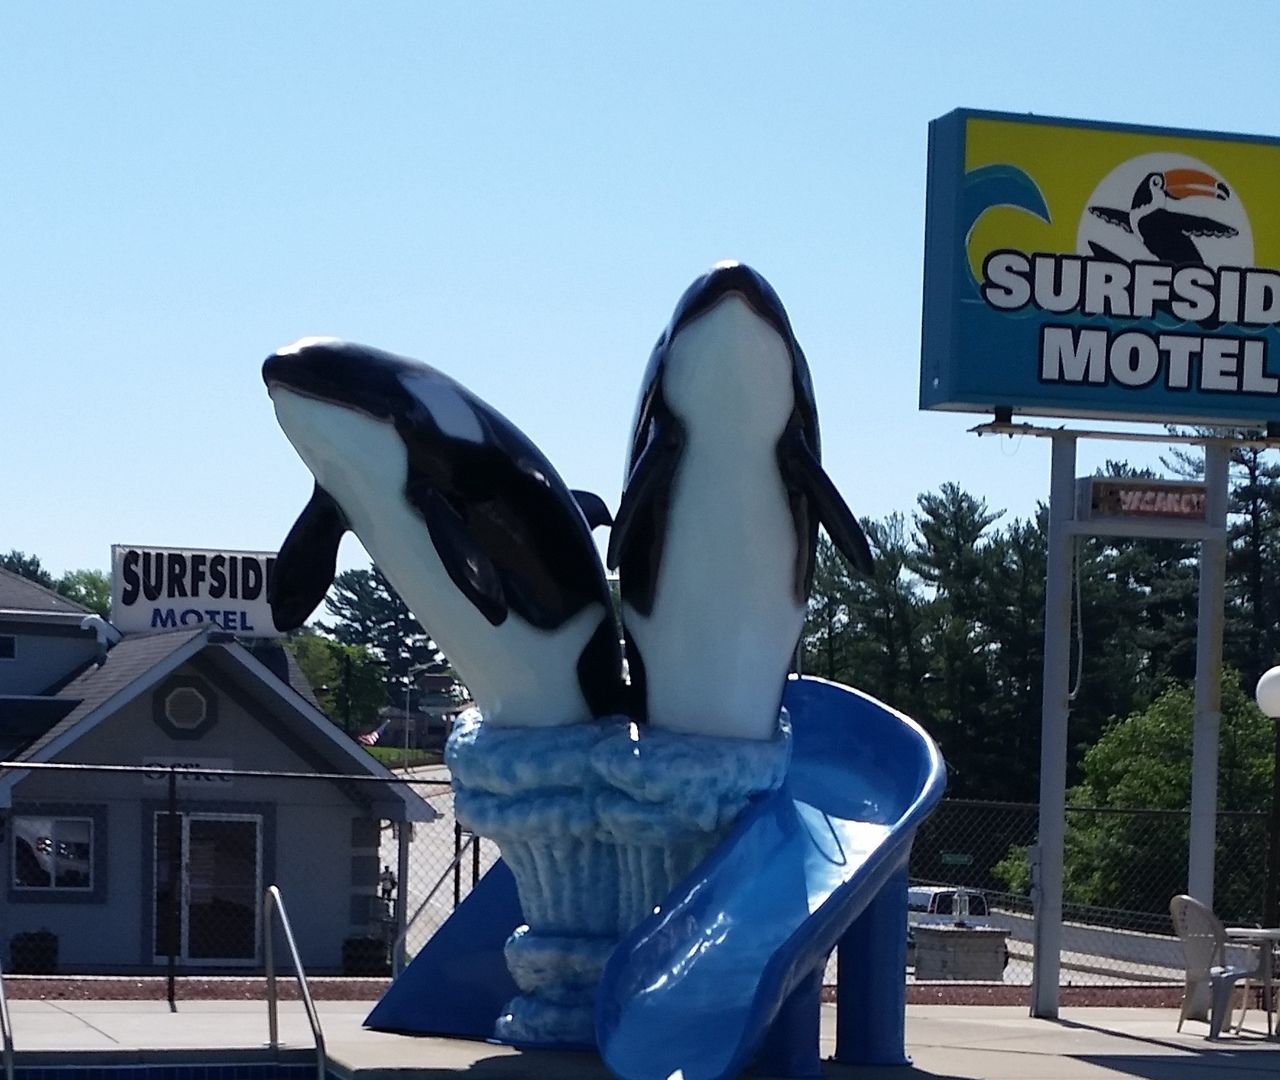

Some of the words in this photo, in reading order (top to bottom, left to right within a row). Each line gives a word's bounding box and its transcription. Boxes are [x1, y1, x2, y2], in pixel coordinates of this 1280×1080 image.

[1040, 327, 1280, 396] MOTEL
[122, 550, 278, 606] SURFSID
[151, 608, 254, 631] MOTEL
